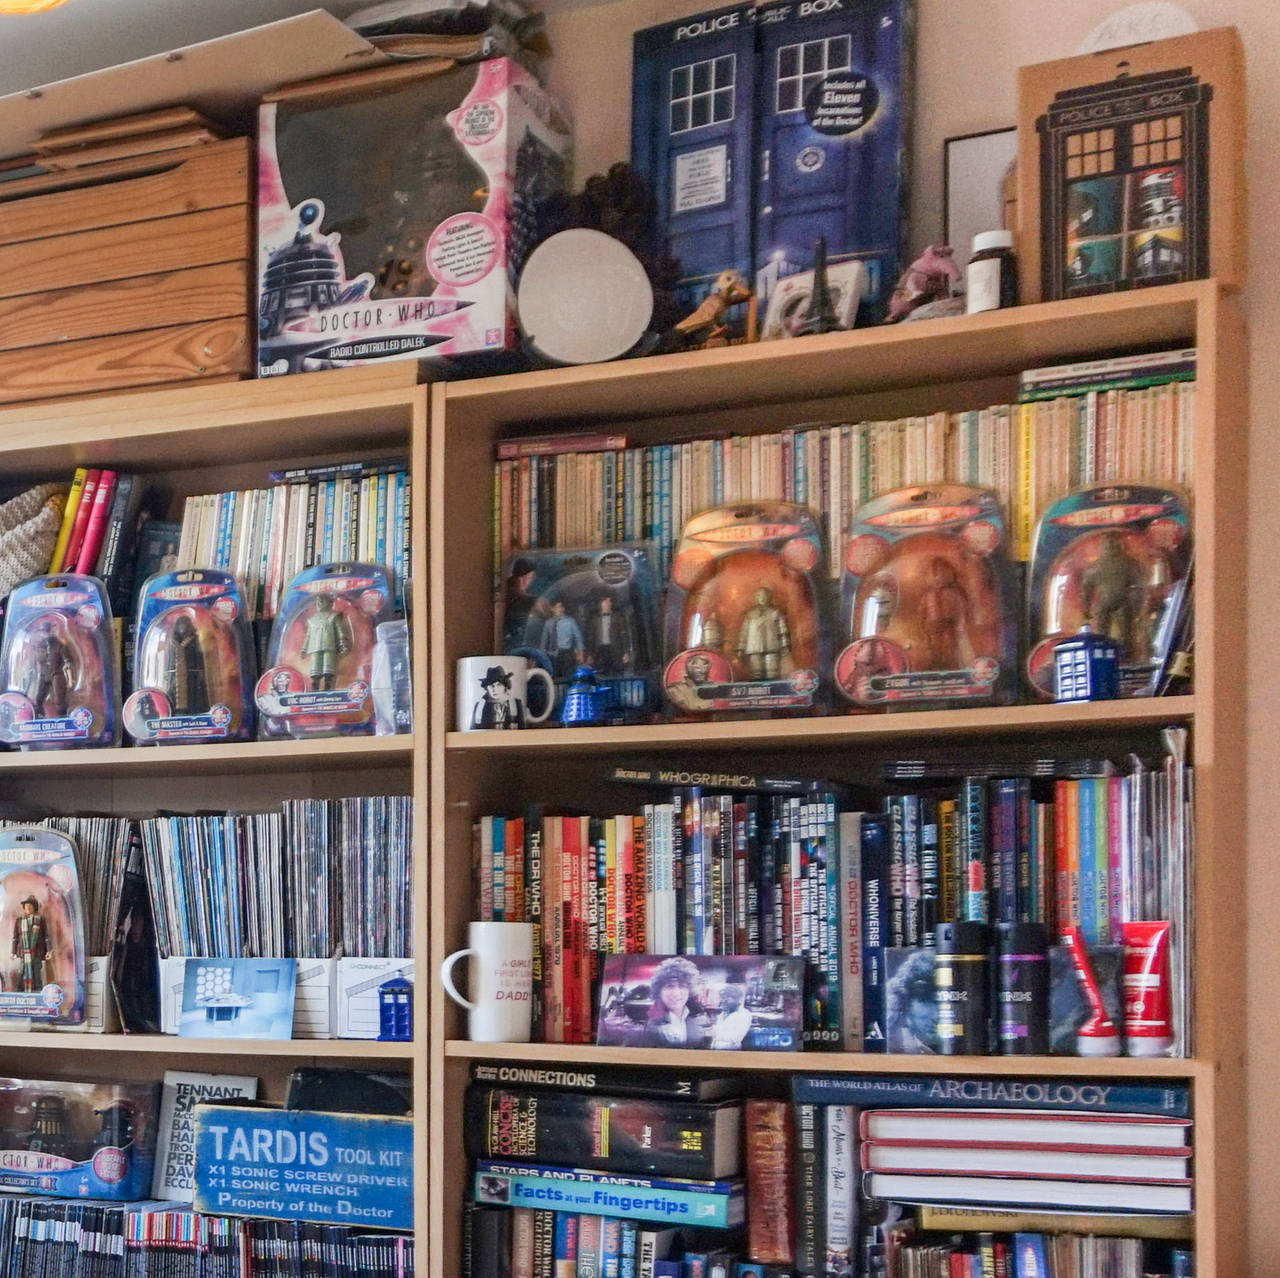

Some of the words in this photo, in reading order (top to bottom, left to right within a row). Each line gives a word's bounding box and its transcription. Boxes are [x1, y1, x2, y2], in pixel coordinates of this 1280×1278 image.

[800, 0, 842, 17] BOX
[676, 12, 739, 41] POLICE
[824, 80, 854, 90] Includes
[824, 92, 861, 103] Eleven
[1059, 104, 1113, 123] POLICE
[1150, 90, 1184, 105] BOX
[320, 308, 383, 332] DOCTOR
[398, 302, 435, 322] WHO
[330, 347, 352, 358] RADIO
[354, 342, 399, 355] CONTROLLED
[401, 336, 426, 348] DALEK
[531, 831, 540, 859] THE
[634, 826, 645, 845] THE
[893, 805, 902, 864] CLASSIC
[531, 860, 541, 880] DR
[634, 847, 645, 902] AMAZING
[891, 863, 905, 895] WHO
[906, 864, 921, 899] WHO
[531, 880, 541, 915] WHO
[589, 882, 597, 922] DOCTOR
[607, 868, 615, 910] DOCTOR
[624, 874, 633, 913] DOCTOR
[810, 879, 818, 912] OFFICIAL
[828, 892, 836, 921] OFFICIAL
[848, 880, 859, 938] DOCTOR
[868, 879, 880, 947] WHONIVERSE
[607, 913, 616, 939] WHO
[625, 916, 633, 939] WHO
[635, 903, 645, 940] WORLD
[810, 915, 818, 946] ANNUAL
[819, 915, 827, 952] ANNUAL
[589, 926, 597, 950] WHO
[829, 925, 837, 955] ANNUAL
[849, 941, 859, 974] WHO
[176, 1083, 253, 1097] TENNANT
[499, 1067, 596, 1087] CONNECTIONS
[831, 1079, 872, 1090] WORLD
[873, 1080, 908, 1092] ATLAS
[928, 1079, 1112, 1106] ARCHAEOLOGY
[519, 1121, 527, 1156] SCIENCE
[528, 1097, 537, 1156] TECHNOLOGY
[209, 1125, 329, 1167] TARDIS
[335, 1148, 375, 1166] TOOL
[379, 1151, 403, 1167] KIT
[37, 1157, 59, 1171] WHO
[209, 1165, 225, 1175] X1
[231, 1166, 279, 1178] SONIC
[284, 1170, 341, 1183] SCREW
[347, 1174, 408, 1187] DRIVER
[805, 1167, 814, 1187] TIME
[209, 1178, 225, 1188] X1
[231, 1180, 280, 1192] SONIC
[285, 1184, 358, 1197] WRENCH
[514, 1183, 564, 1201] Facts
[593, 1191, 689, 1214] Fingertips
[805, 1191, 814, 1212] LORD
[218, 1193, 284, 1212] Property
[290, 1202, 304, 1211] of
[308, 1203, 332, 1214] the
[337, 1201, 394, 1218] Doctor
[542, 1211, 552, 1254] DOCTOR
[806, 1215, 814, 1239] FAIRY
[581, 1252, 595, 1278] THE
[607, 1258, 617, 1277] THE
[642, 1242, 653, 1264] THE
[807, 1242, 815, 1267] TALES
[981, 1247, 993, 1278] BLAKE'S
[996, 1257, 1006, 1276] THE
